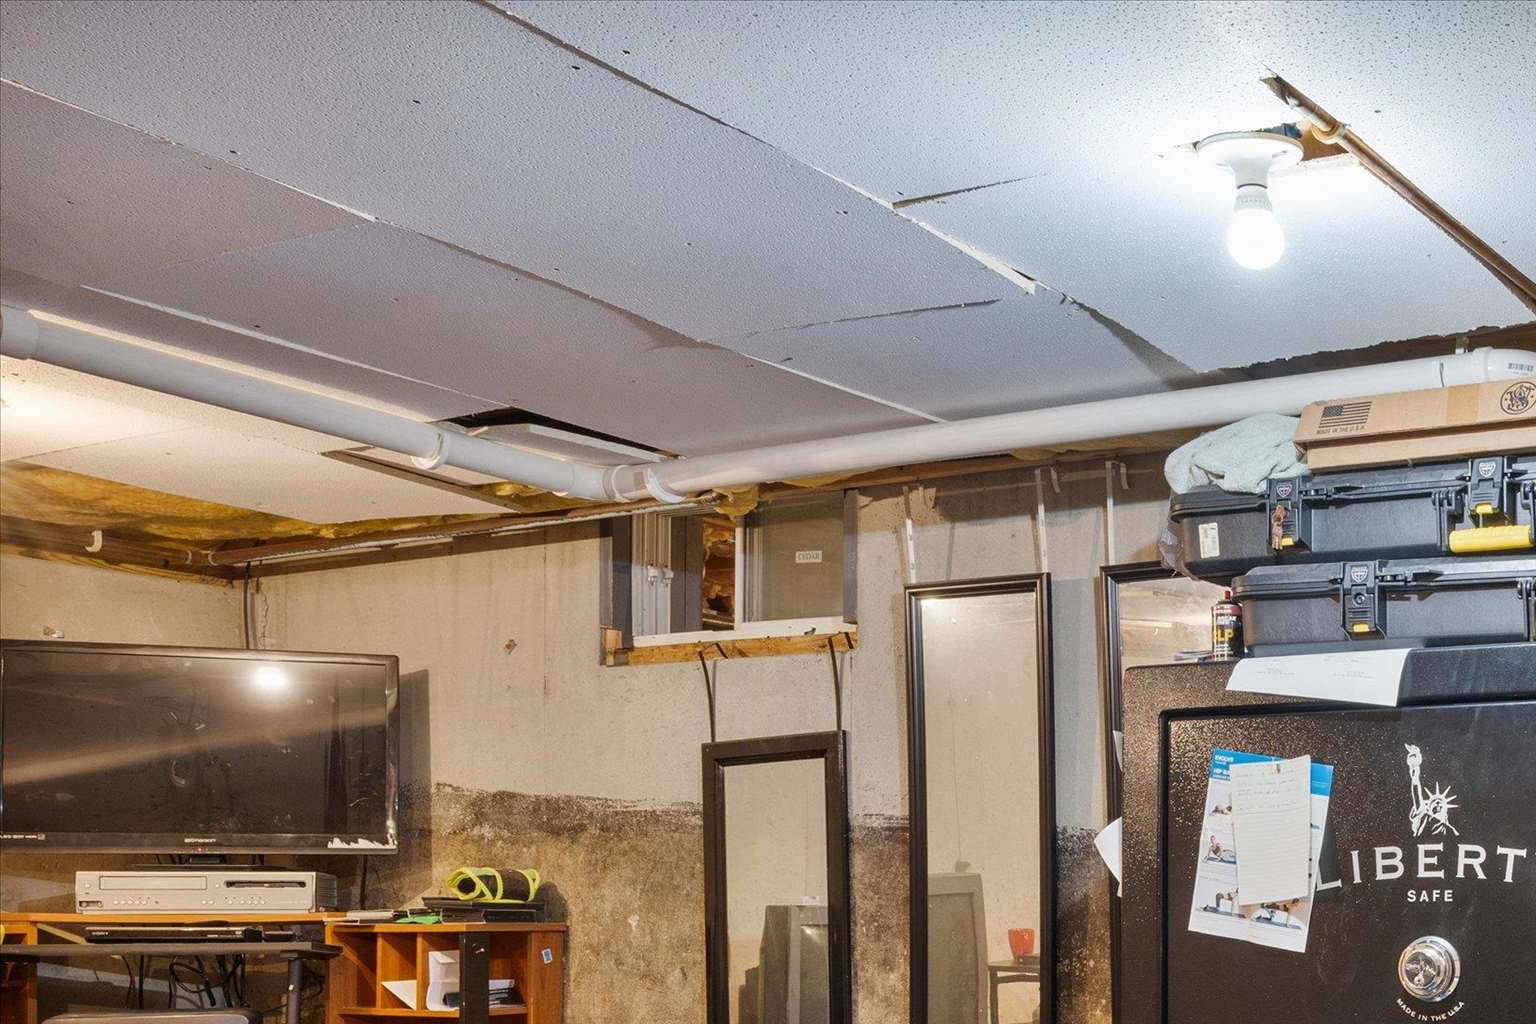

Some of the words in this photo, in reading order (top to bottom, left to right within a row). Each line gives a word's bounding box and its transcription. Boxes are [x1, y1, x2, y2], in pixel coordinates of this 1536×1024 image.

[1407, 889, 1454, 902] SAFE
[1396, 998, 1417, 1018] MADE
[1430, 1012, 1447, 1022] THE
